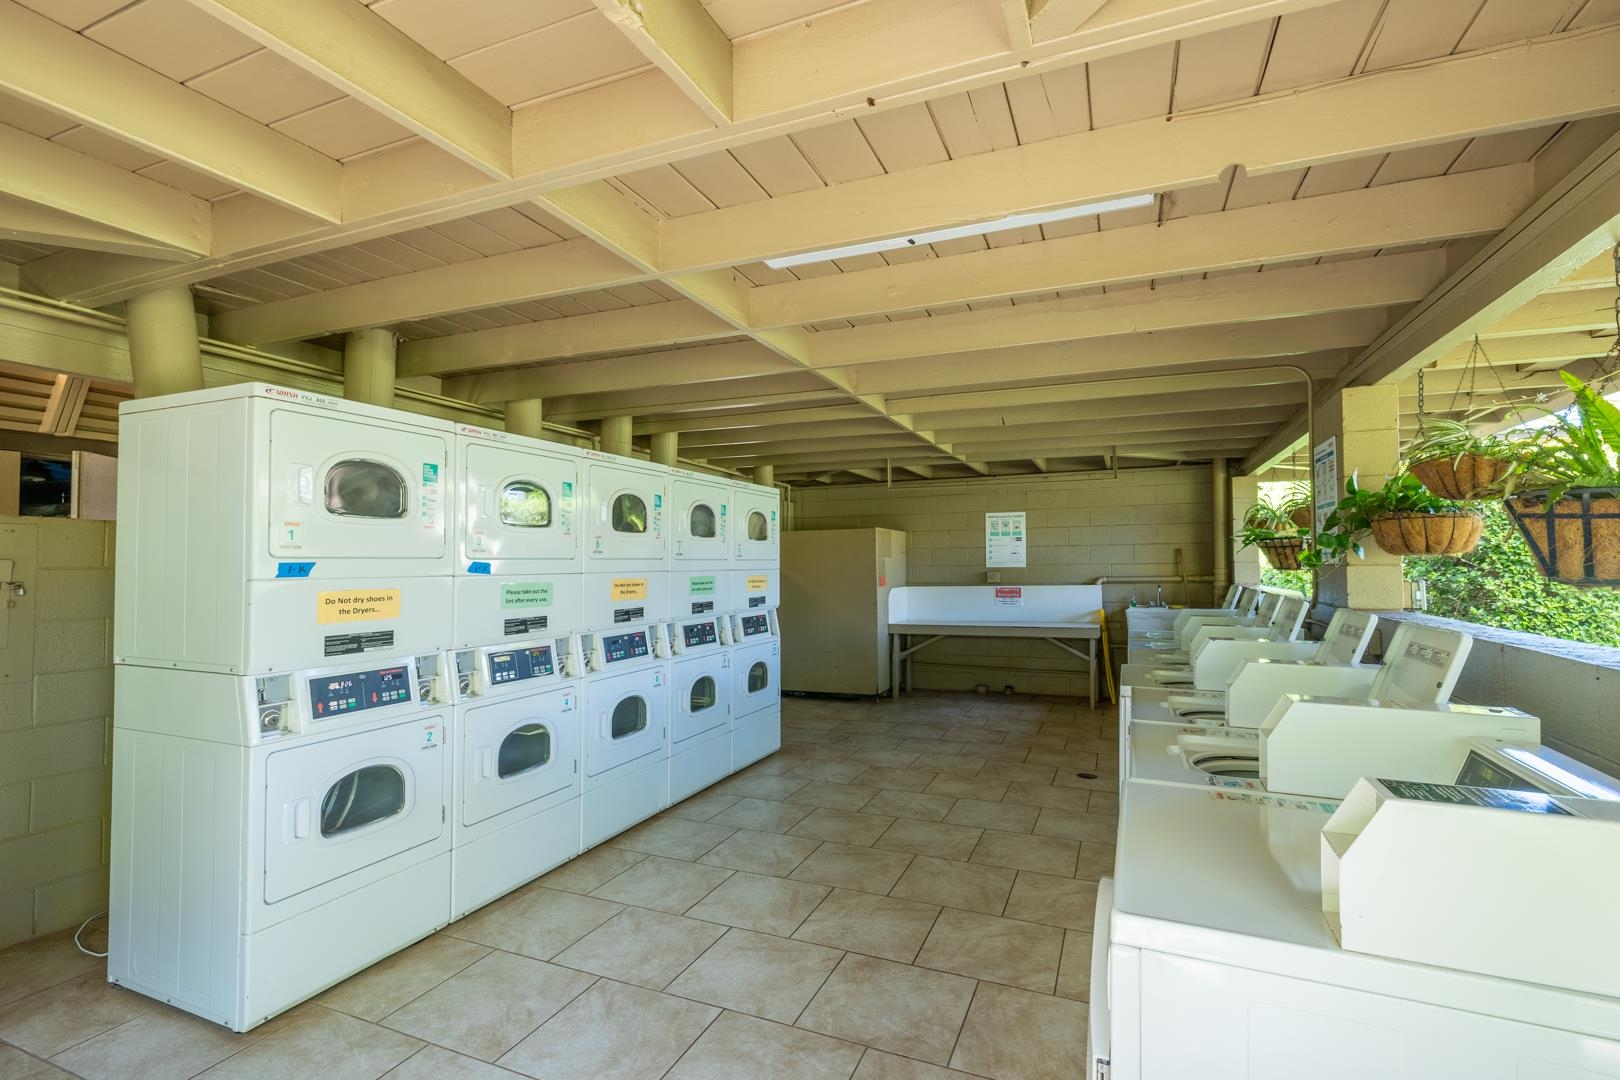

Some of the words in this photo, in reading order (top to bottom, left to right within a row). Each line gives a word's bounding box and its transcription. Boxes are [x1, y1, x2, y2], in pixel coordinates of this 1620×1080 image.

[287, 529, 294, 541] 1
[352, 596, 364, 604] dry
[427, 731, 432, 741] 2
